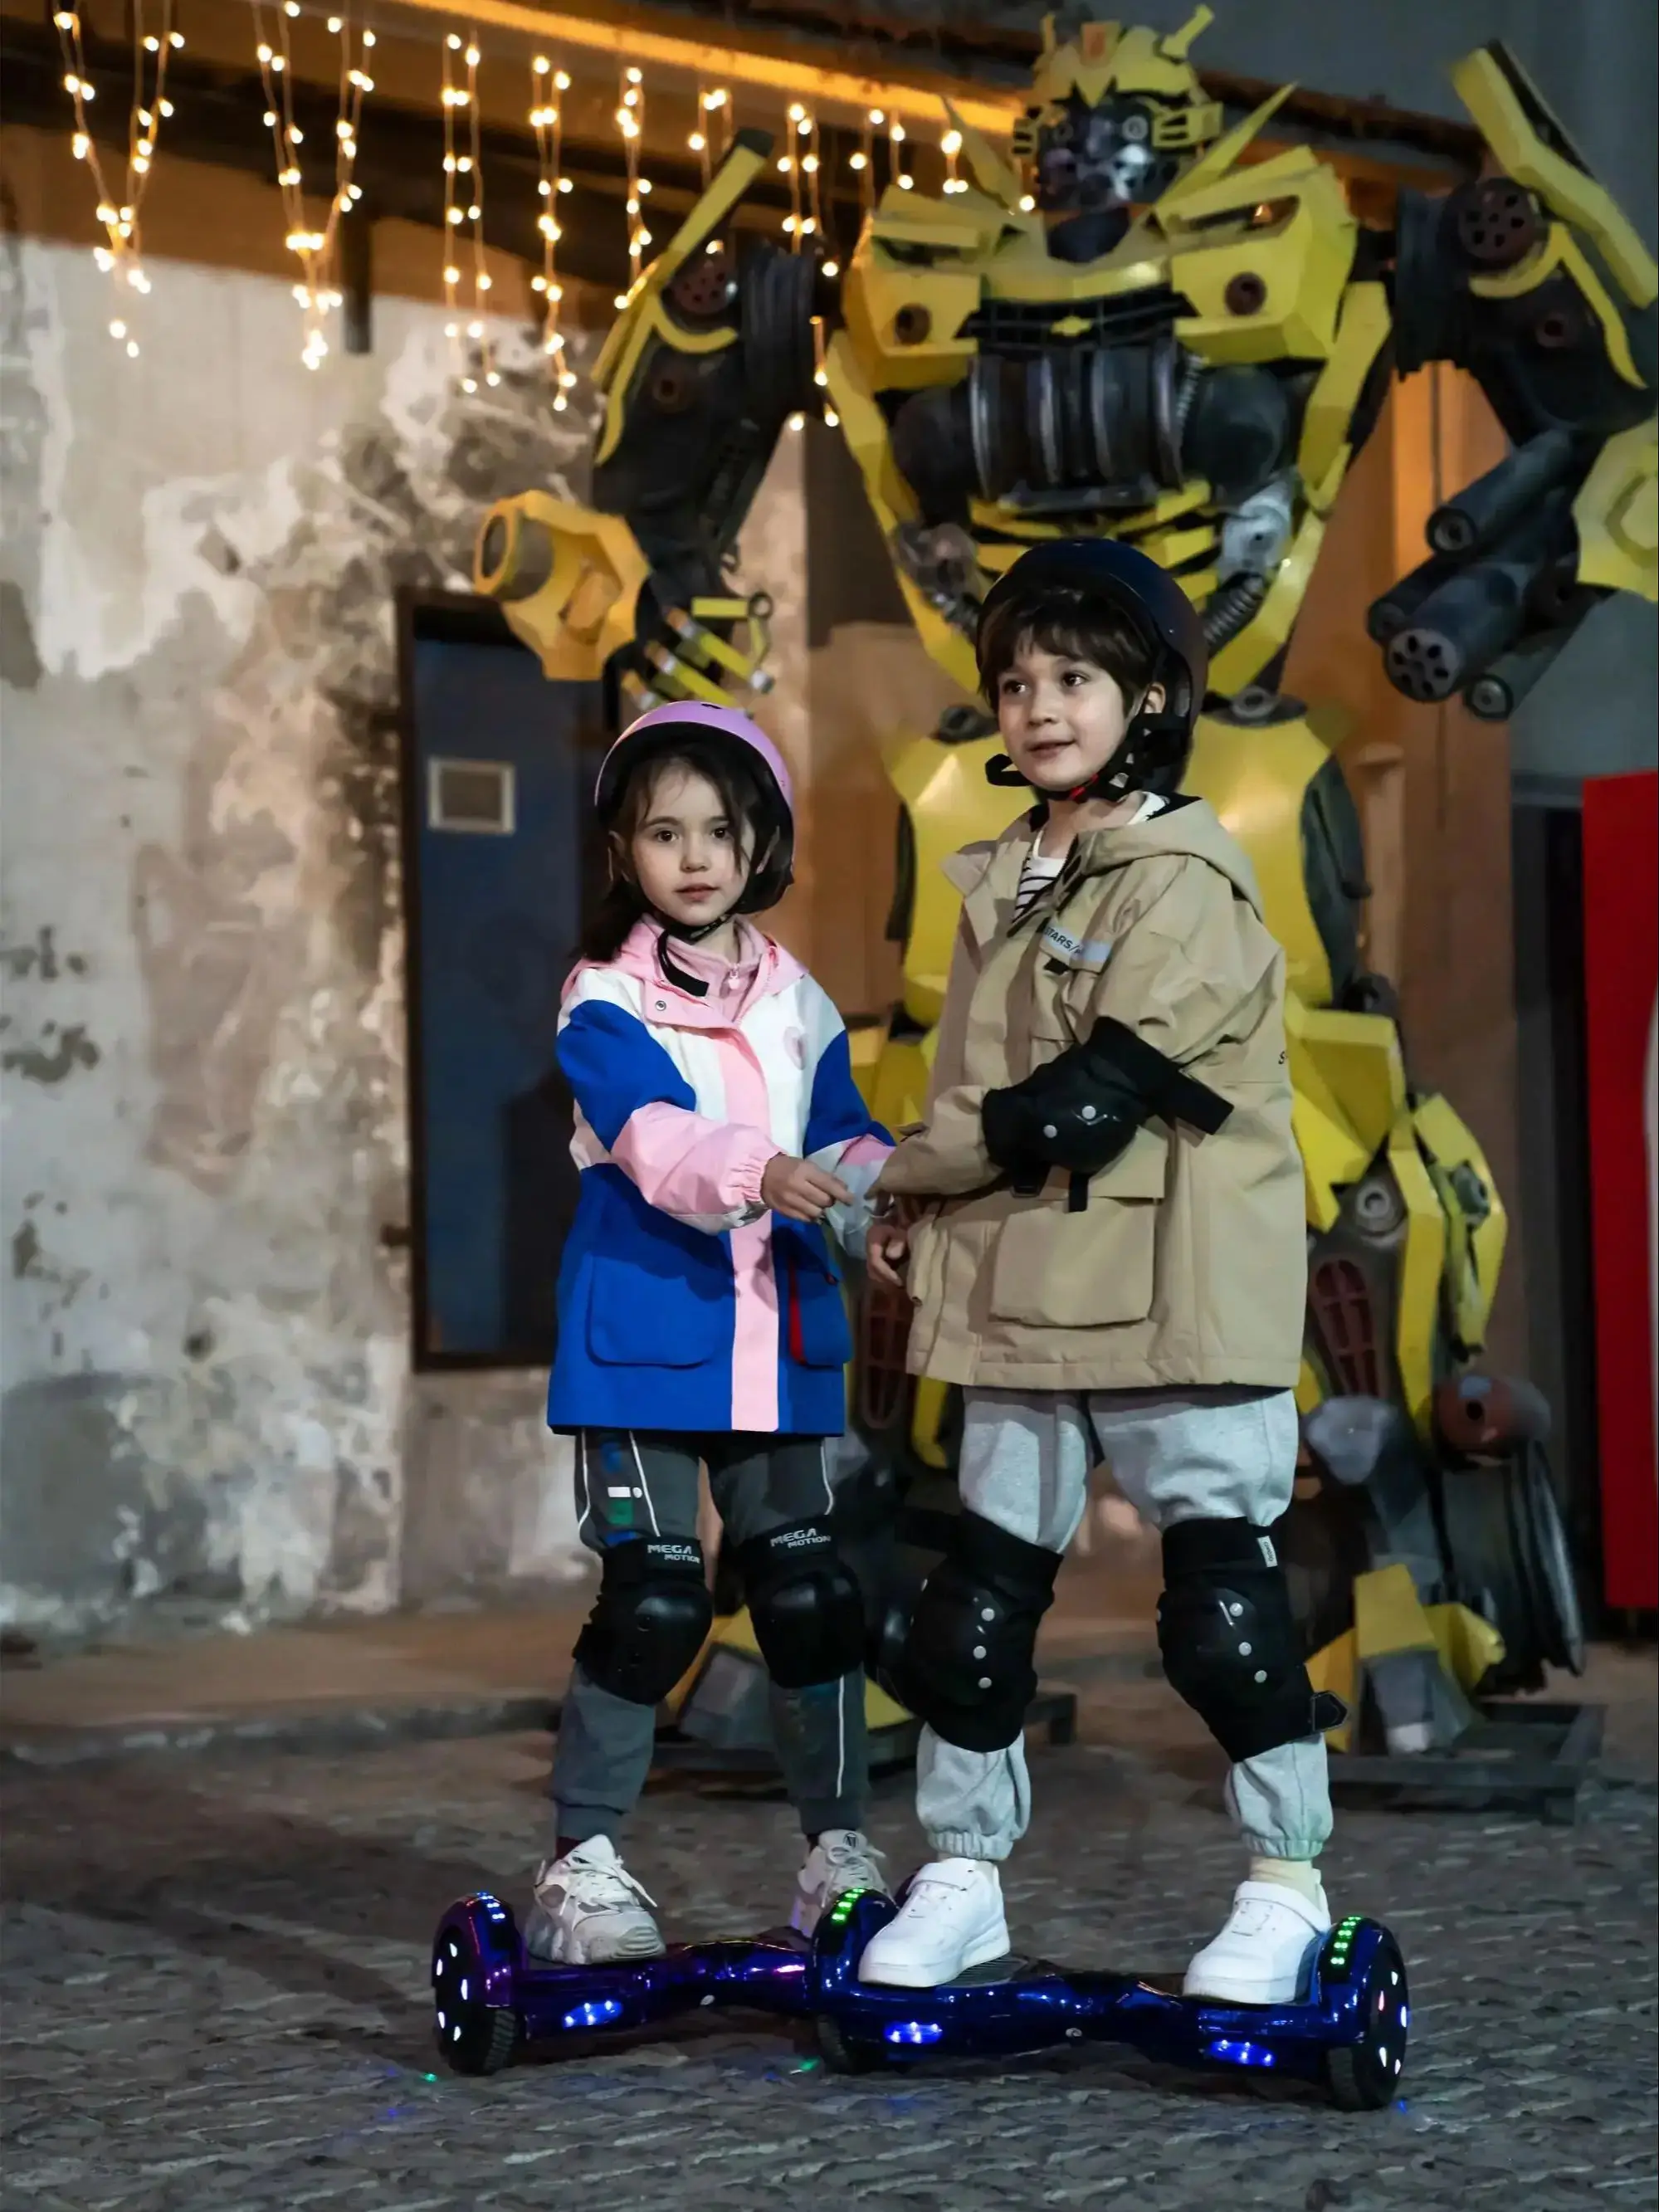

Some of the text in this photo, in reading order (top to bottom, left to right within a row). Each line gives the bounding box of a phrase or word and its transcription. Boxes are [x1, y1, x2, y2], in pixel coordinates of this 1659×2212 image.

[770, 1528, 817, 1547] MEGA
[788, 1536, 831, 1548] MOTION
[647, 1544, 692, 1554] MEGA
[664, 1554, 700, 1564] MOTION
